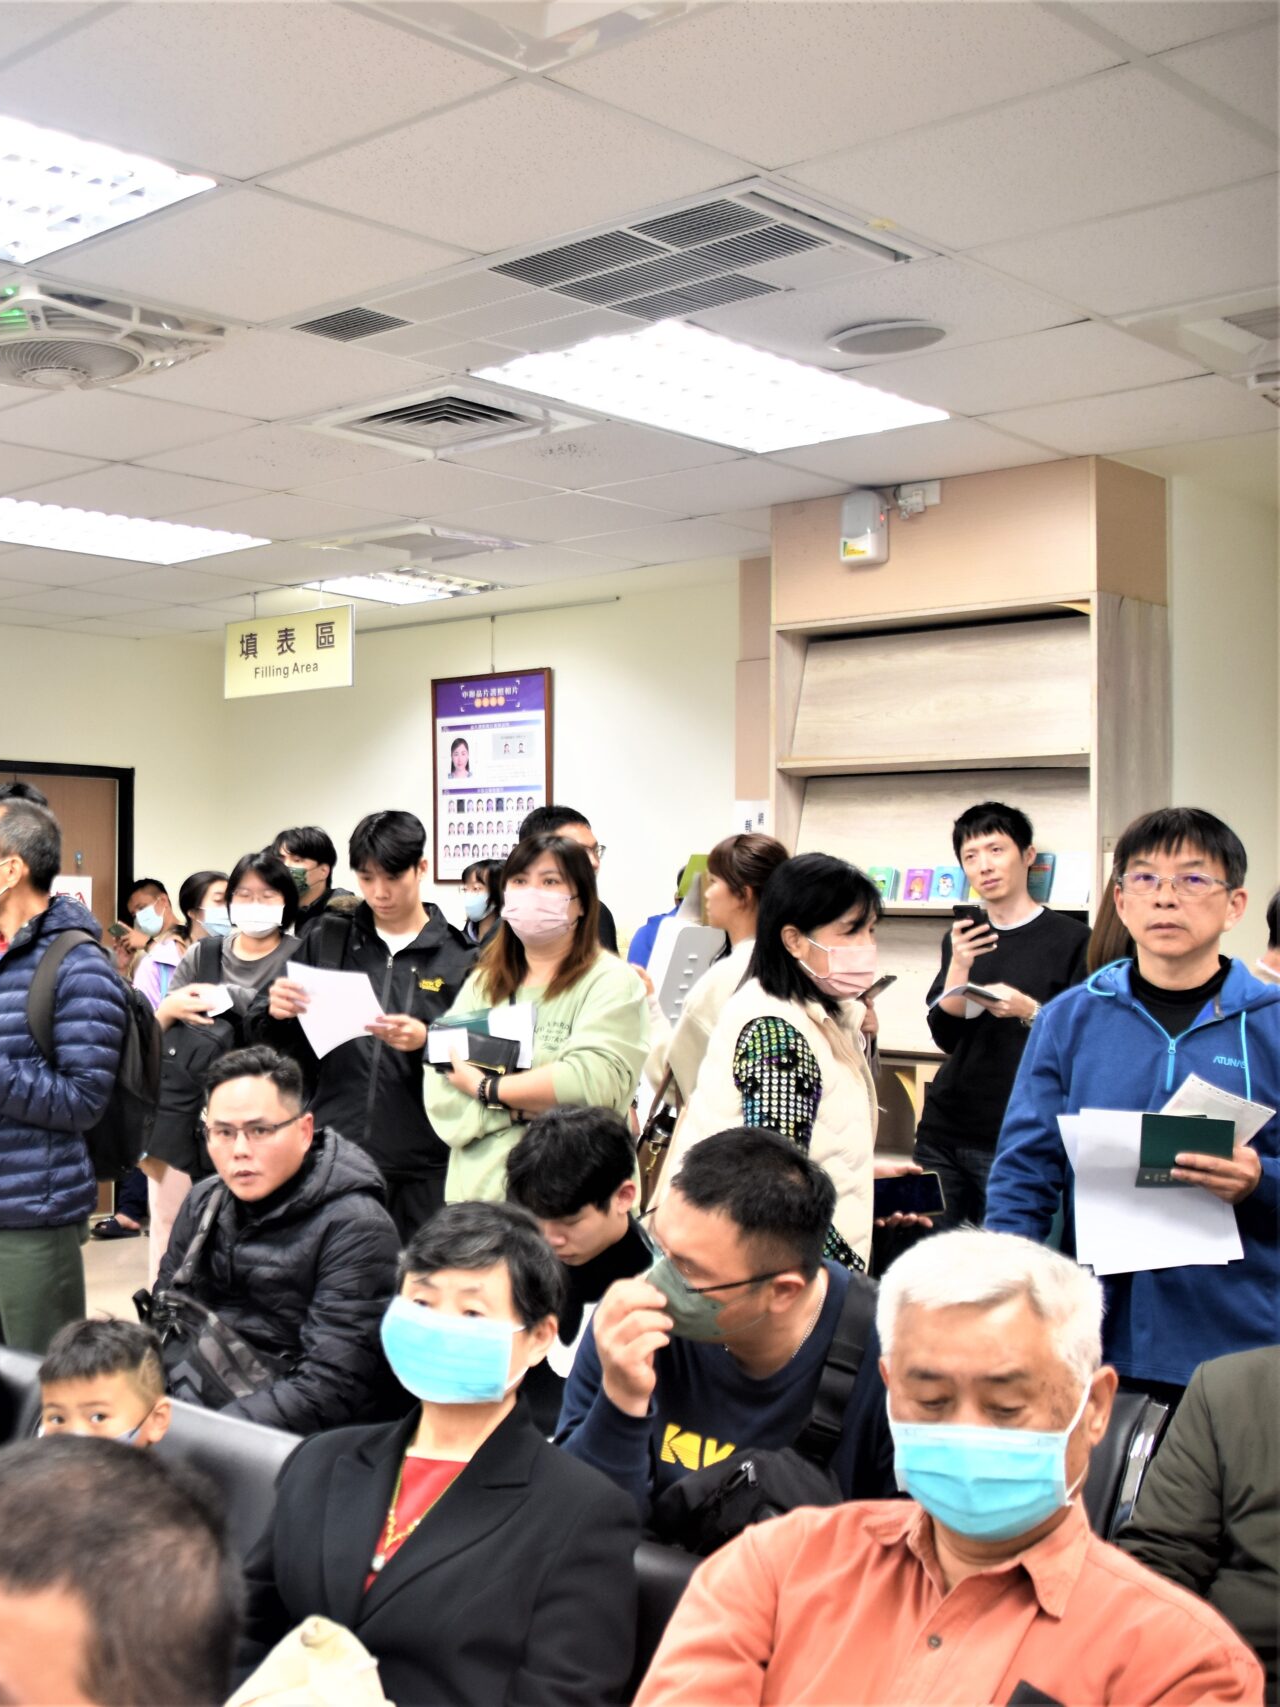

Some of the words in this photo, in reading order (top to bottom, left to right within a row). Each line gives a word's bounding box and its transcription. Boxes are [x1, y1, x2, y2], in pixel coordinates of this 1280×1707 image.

[239, 621, 335, 660] 填表區
[254, 665, 289, 679] Filling
[292, 662, 319, 674] Area
